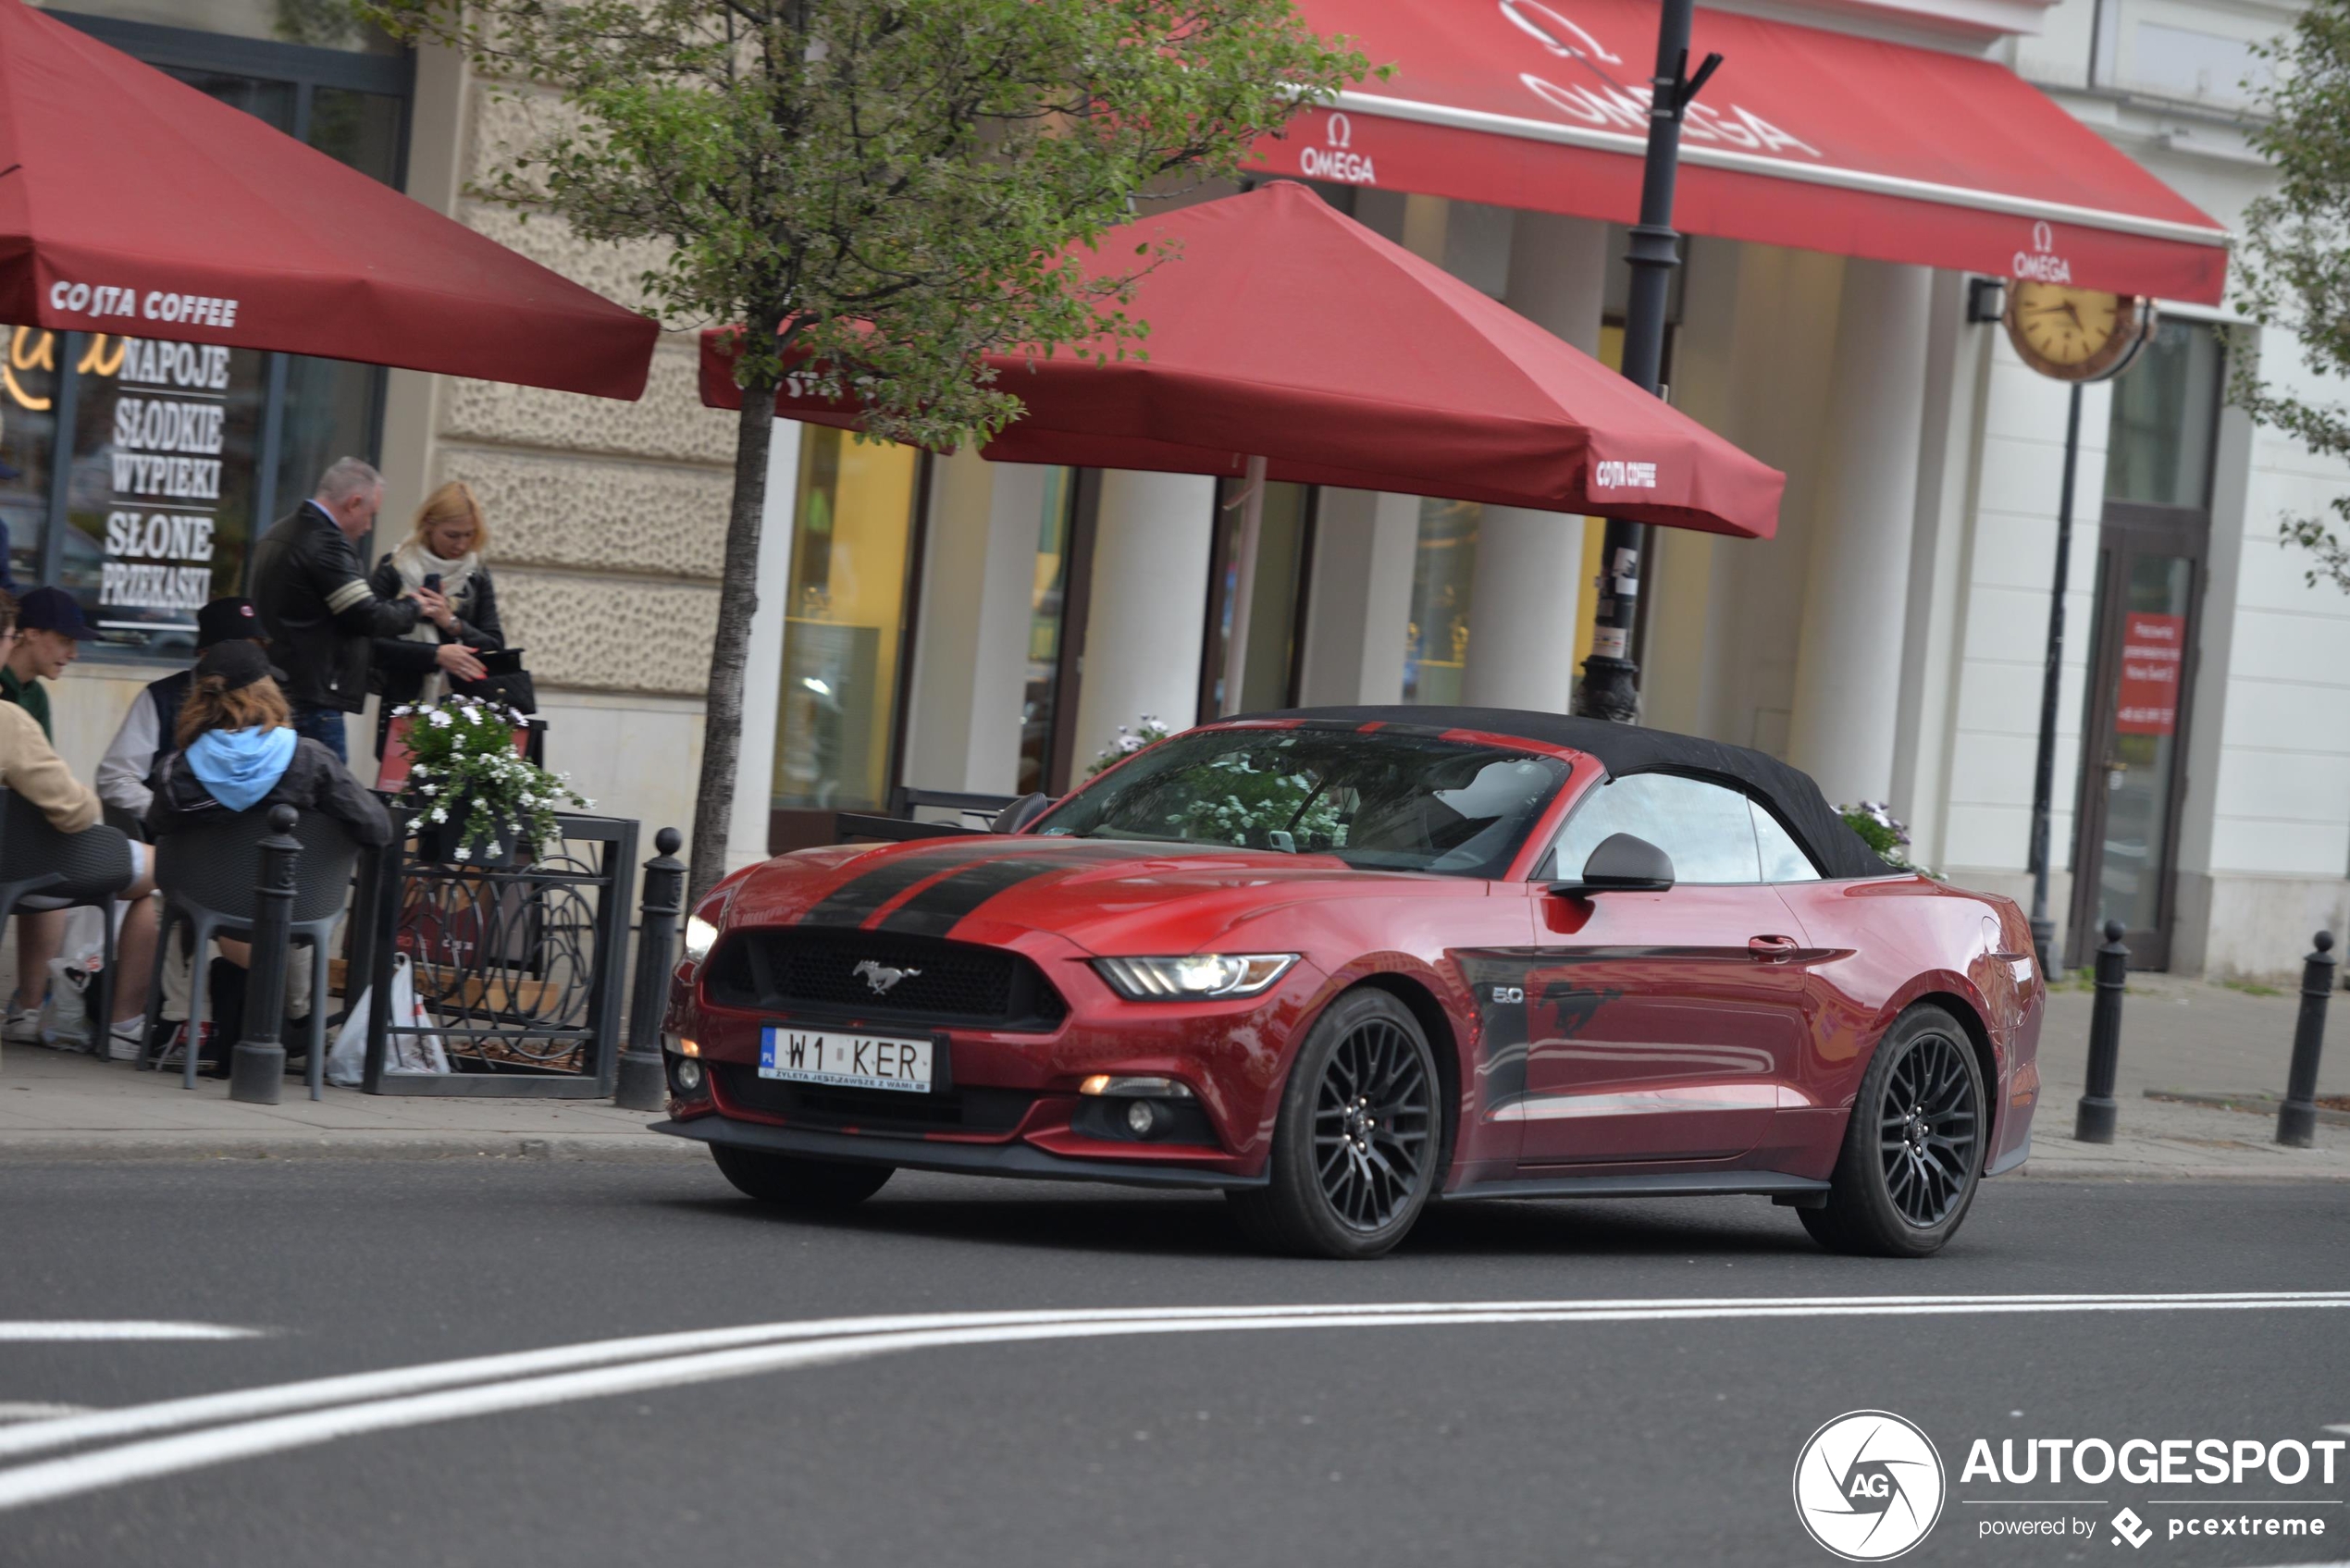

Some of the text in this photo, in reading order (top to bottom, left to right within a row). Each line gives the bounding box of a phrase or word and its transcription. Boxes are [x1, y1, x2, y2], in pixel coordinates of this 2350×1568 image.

[1300, 146, 1377, 184] OMEGA
[2013, 251, 2072, 283] OMEGA
[50, 280, 238, 328] COSTA COFFEE
[118, 337, 229, 389] NAPOJE
[113, 397, 225, 454] SŁODKIE
[113, 452, 223, 499] WYPIEKI
[1596, 461, 1626, 489] COSTA
[105, 511, 215, 562] SŁONE
[762, 1052, 773, 1064] PL
[790, 1034, 916, 1080] W1 KER
[886, 1081, 912, 1090] WAMI
